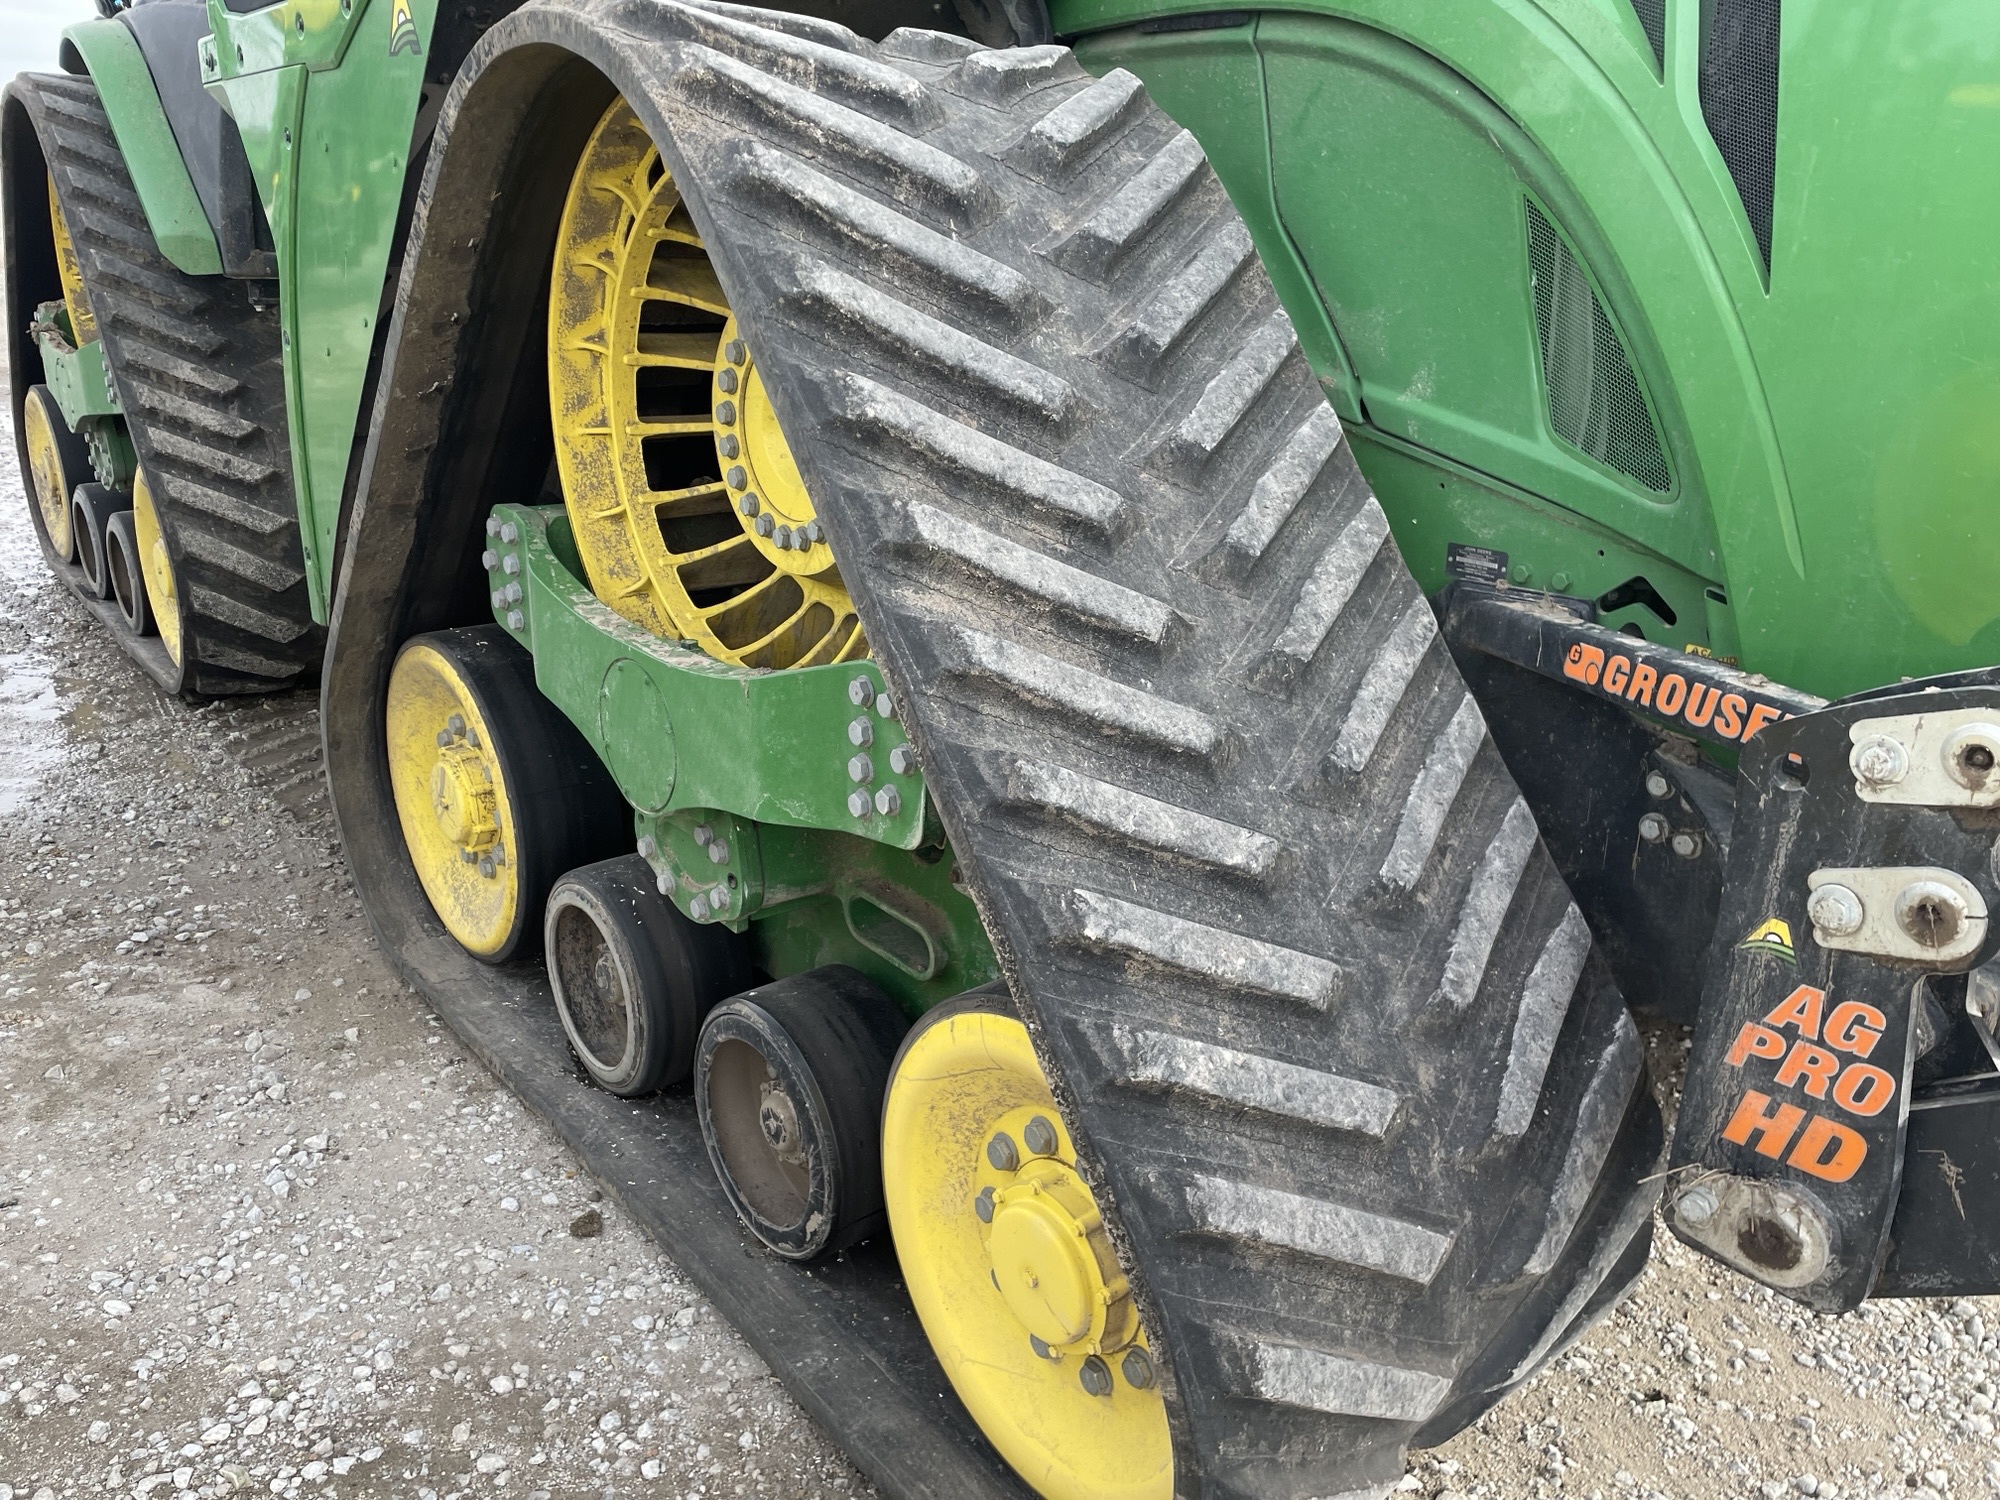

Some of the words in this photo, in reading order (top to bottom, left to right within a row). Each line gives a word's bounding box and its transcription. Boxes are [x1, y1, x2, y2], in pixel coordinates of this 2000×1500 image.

[1763, 984, 1887, 1059] AG
[1723, 1021, 1896, 1117] PRO
[1721, 1089, 1867, 1183] HD
